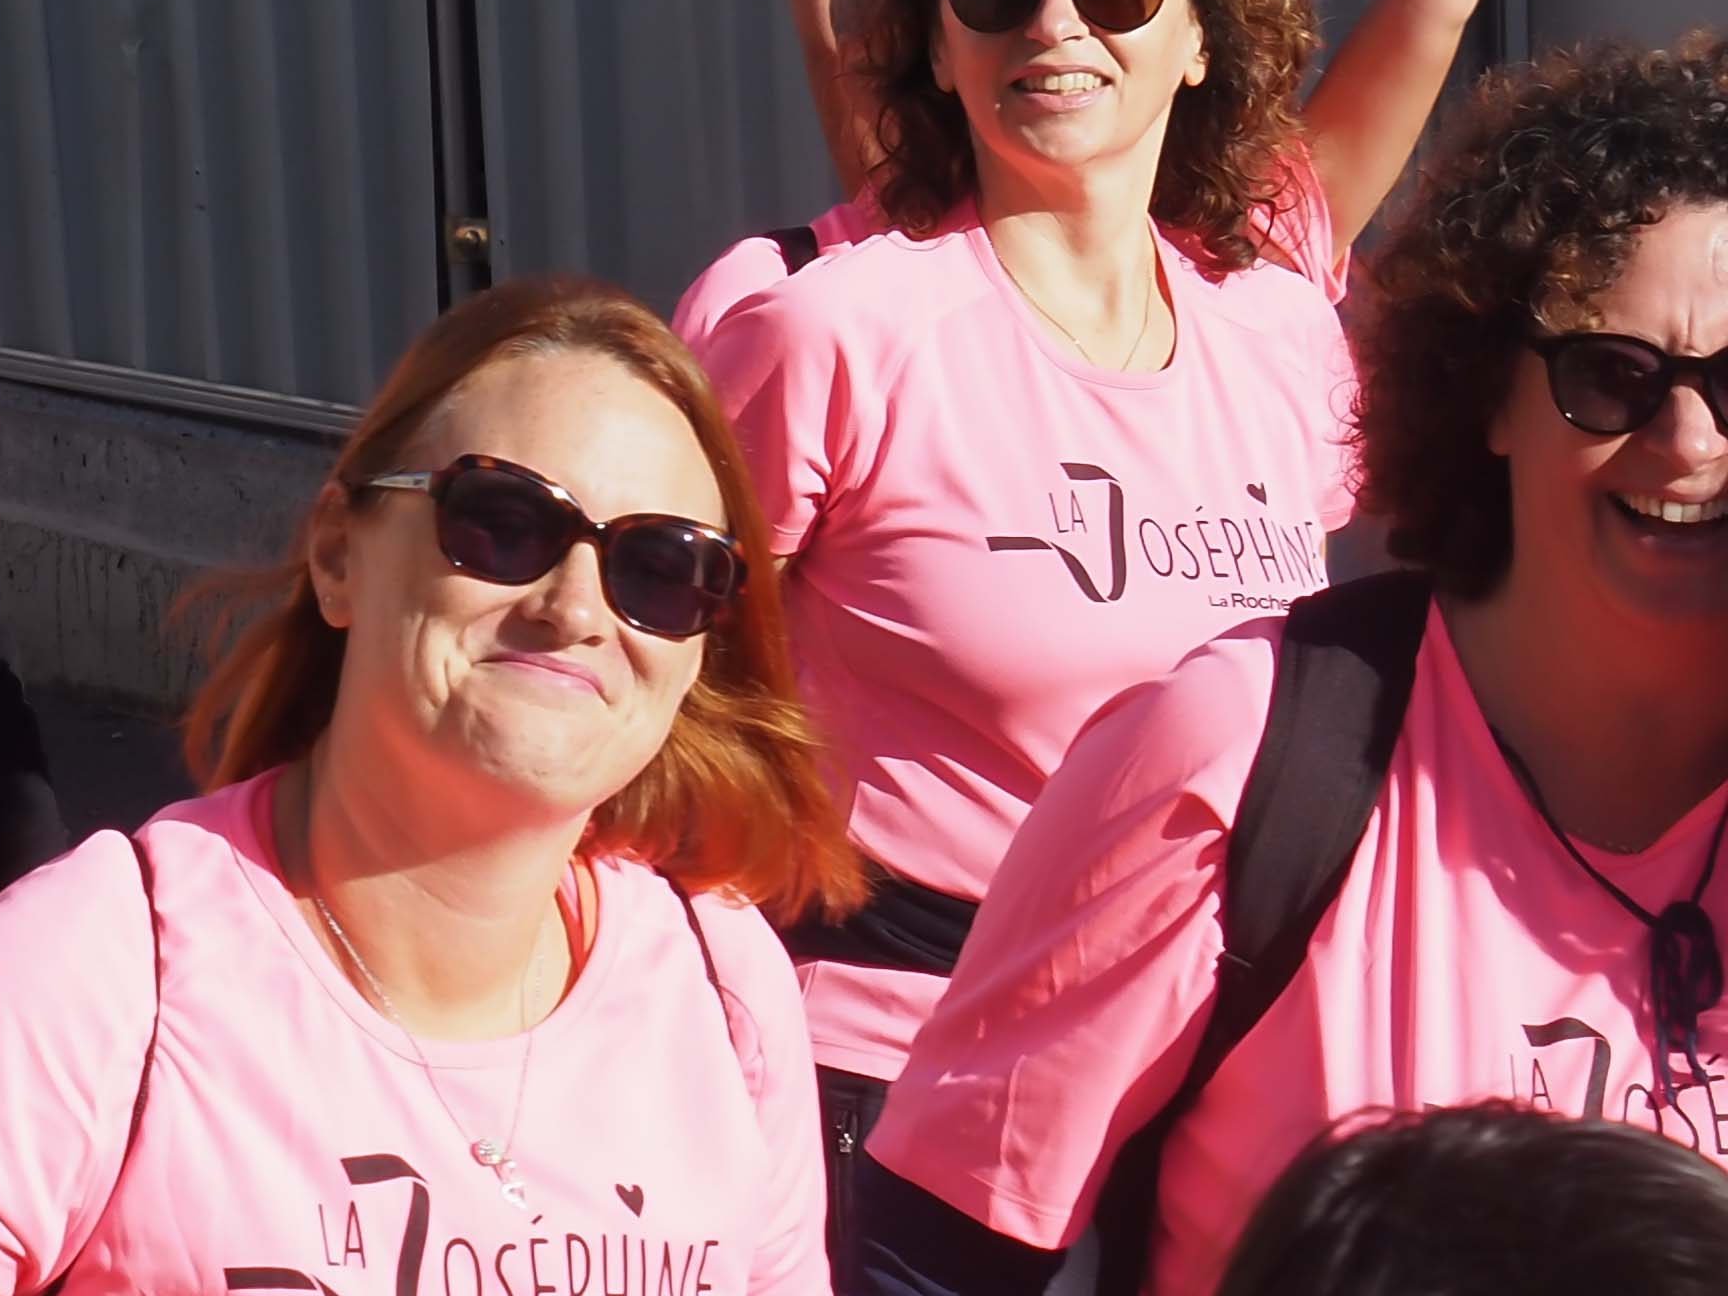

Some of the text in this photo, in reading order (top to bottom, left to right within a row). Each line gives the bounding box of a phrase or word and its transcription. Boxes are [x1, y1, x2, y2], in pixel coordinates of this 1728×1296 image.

[1048, 488, 1088, 534] LA
[1208, 594, 1229, 609] La
[318, 1200, 366, 1270] LA
